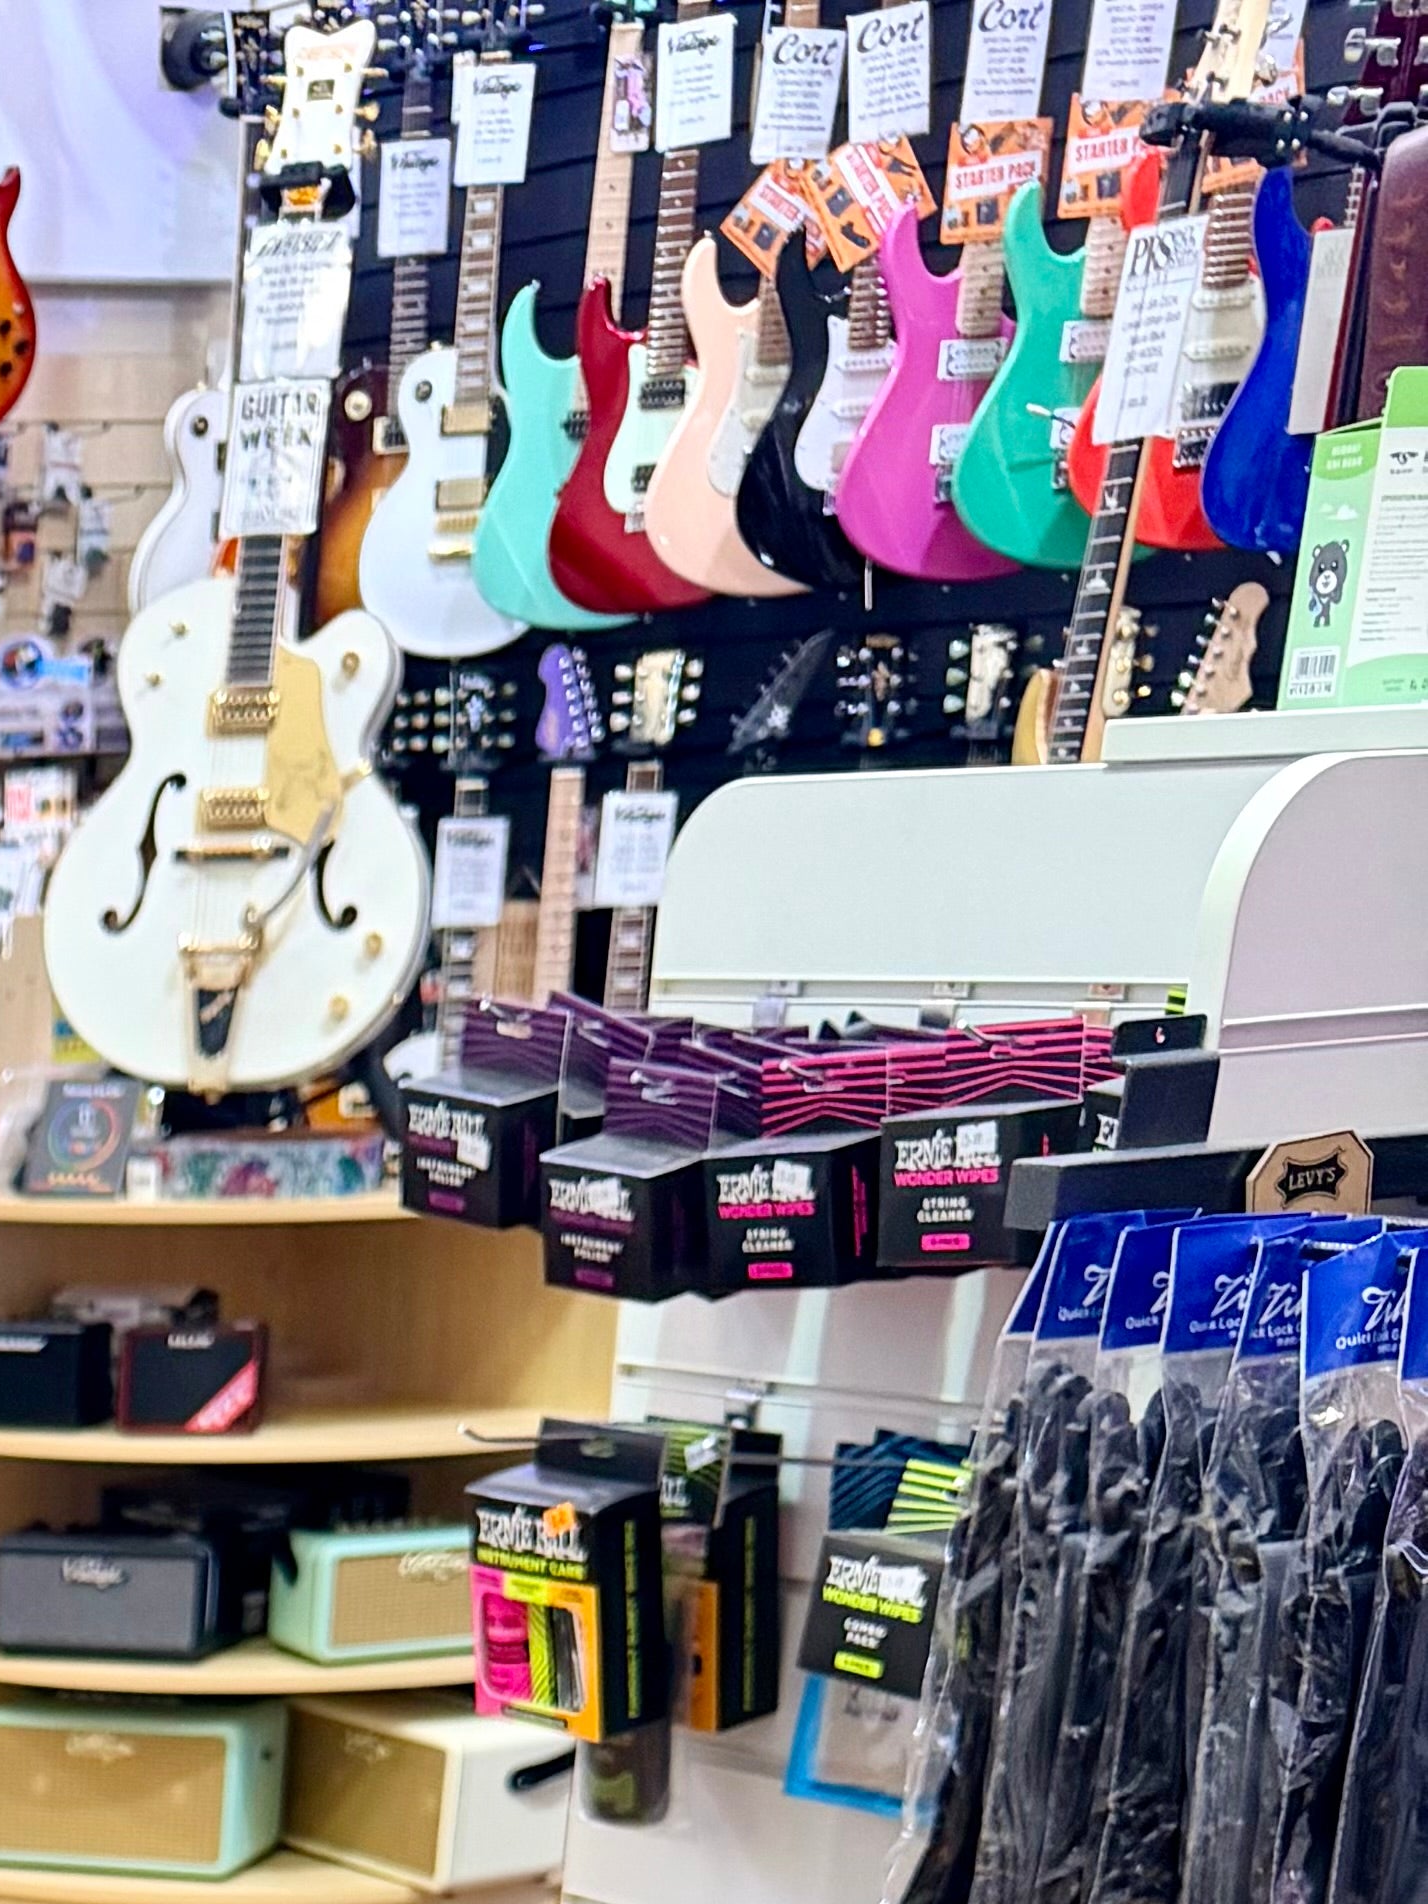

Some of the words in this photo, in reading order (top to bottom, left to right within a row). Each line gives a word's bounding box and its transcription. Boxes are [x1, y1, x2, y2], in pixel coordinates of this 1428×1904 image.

[857, 11, 924, 54] Cort
[978, 0, 1044, 33] Cort
[773, 33, 838, 66] Cort
[954, 168, 1004, 190] STARTER
[894, 1129, 953, 1171] ERNIE
[716, 1163, 770, 1205] ERNIE
[894, 1169, 954, 1186] WONDER
[957, 1167, 999, 1184] WIPES
[1288, 1166, 1336, 1190] LEVY'S
[476, 1503, 535, 1552] ERNIE
